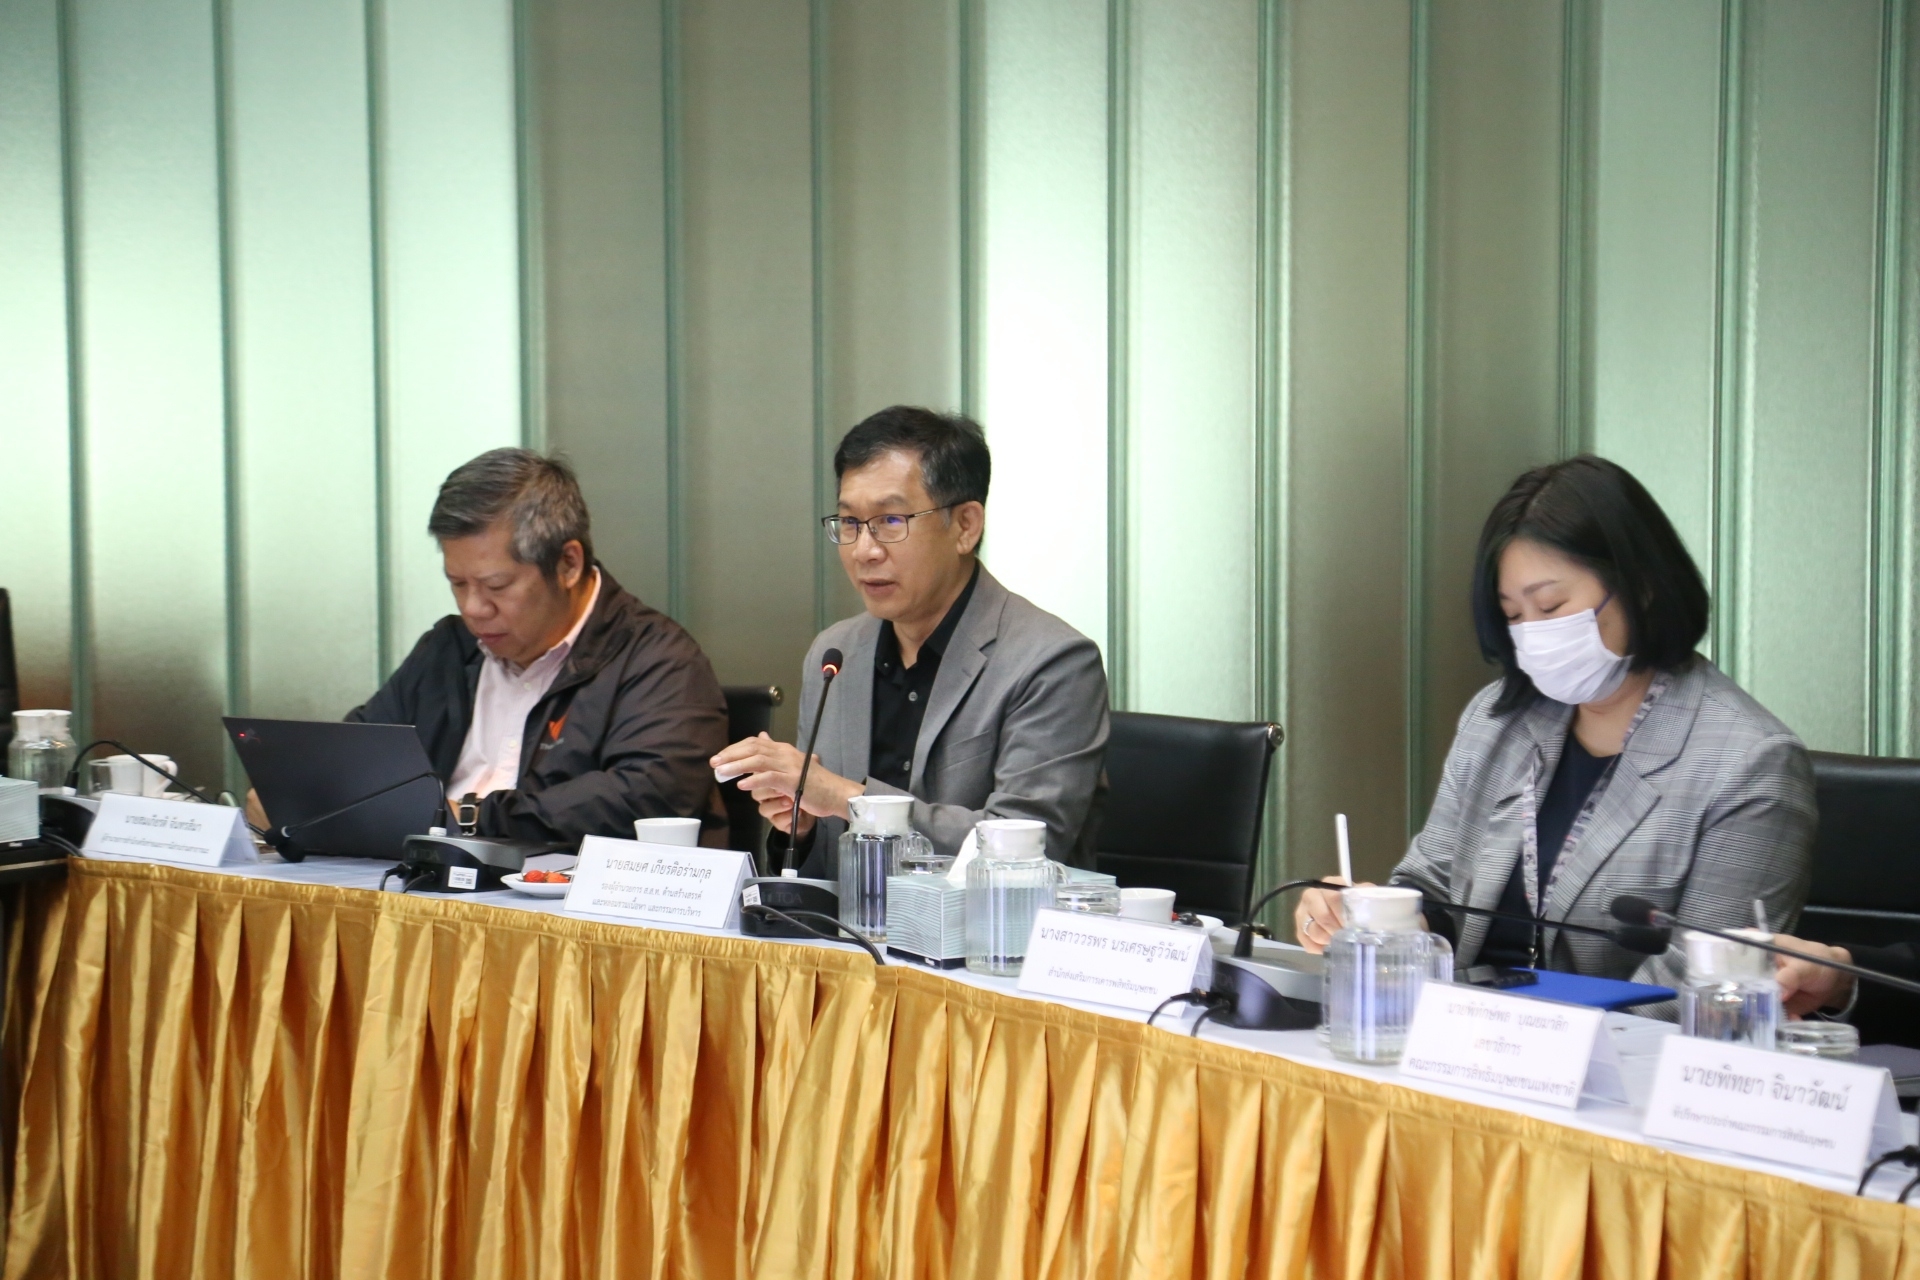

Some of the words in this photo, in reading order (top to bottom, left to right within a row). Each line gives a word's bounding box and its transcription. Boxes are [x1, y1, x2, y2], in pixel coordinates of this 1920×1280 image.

[606, 858, 650, 873] นายสมยศ
[650, 859, 713, 883] เกียรติอร่ามกุล
[1040, 926, 1109, 949] นางสาววรพร
[1681, 1063, 1766, 1097] นายพิทยา
